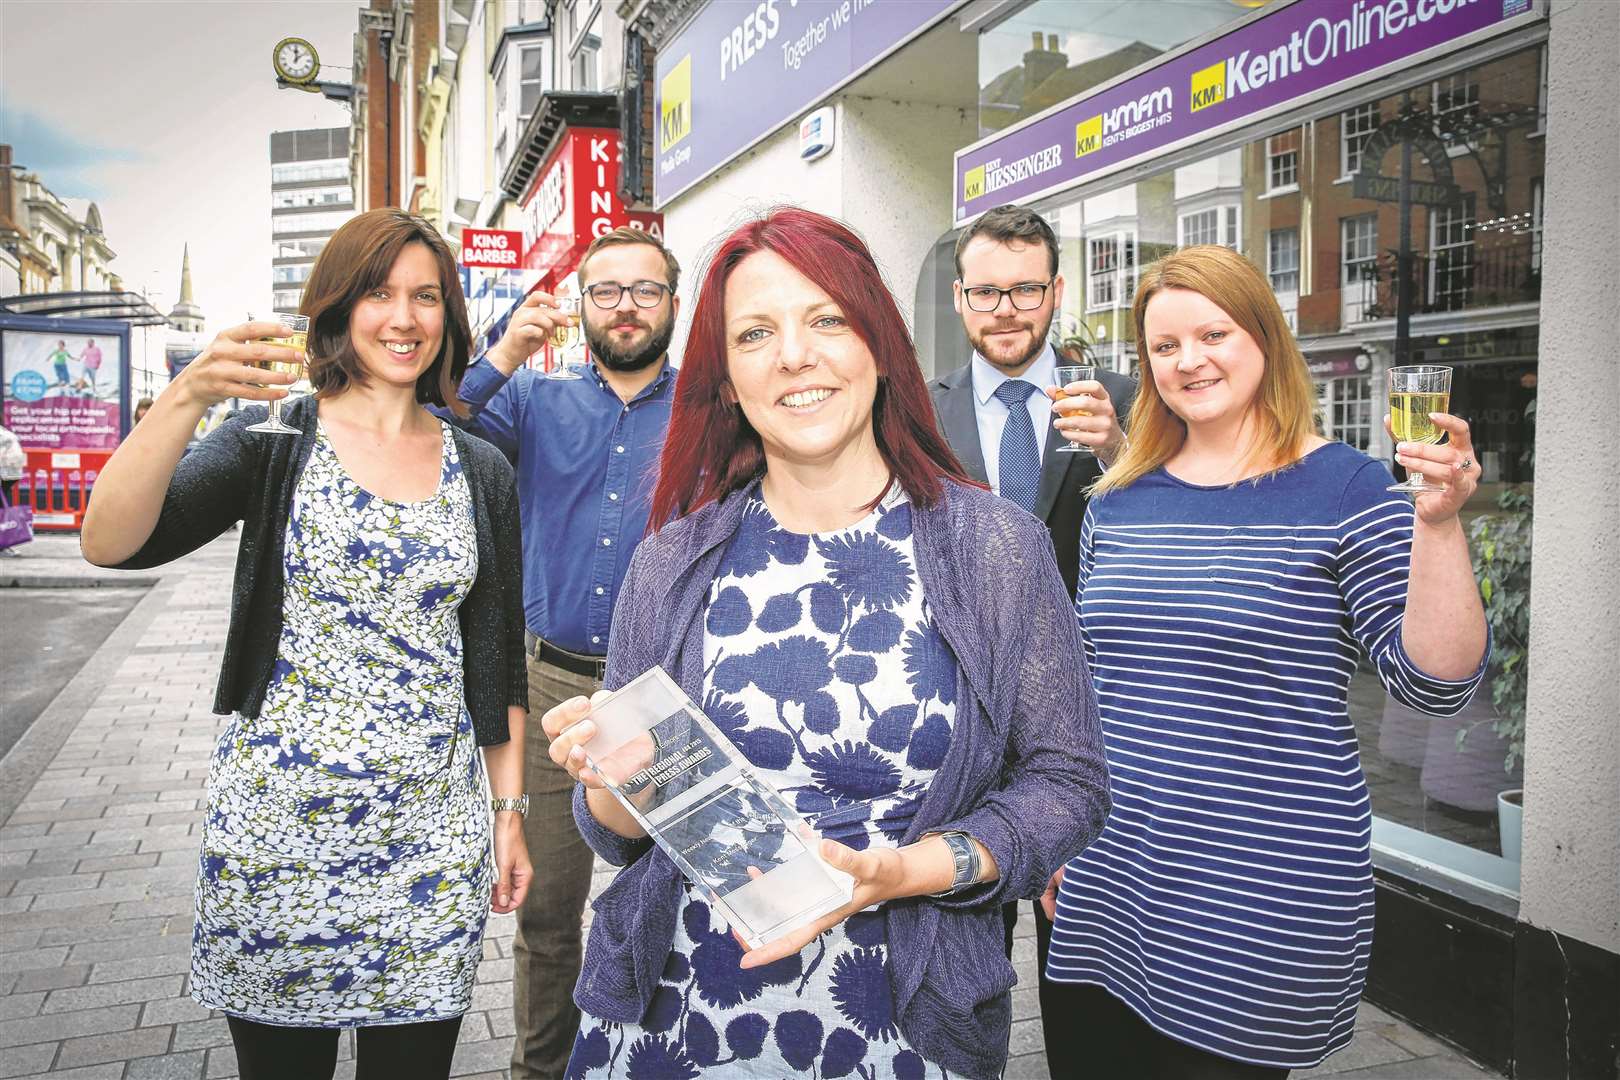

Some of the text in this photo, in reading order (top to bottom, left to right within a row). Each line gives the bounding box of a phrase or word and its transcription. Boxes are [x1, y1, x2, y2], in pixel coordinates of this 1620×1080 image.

[720, 0, 780, 81] PRESS
[782, 16, 830, 71] Together
[831, 1, 851, 31] we
[1192, 84, 1216, 110] KM
[663, 102, 682, 147] KM
[1125, 119, 1156, 140] BIGGEST
[1155, 111, 1173, 128] HITS
[1077, 134, 1095, 155] KM
[985, 143, 1063, 194] MESSENGER
[590, 138, 614, 239] KING
[965, 183, 980, 199] KM
[464, 247, 517, 265] BARBER
[472, 233, 508, 250] KING
[10, 406, 28, 415] Get
[30, 408, 52, 416] your
[53, 408, 70, 416] hip
[71, 416, 96, 425] from
[631, 772, 649, 786] THE
[647, 750, 685, 776] REGIONAL
[655, 746, 712, 784] PRESS AWARDS
